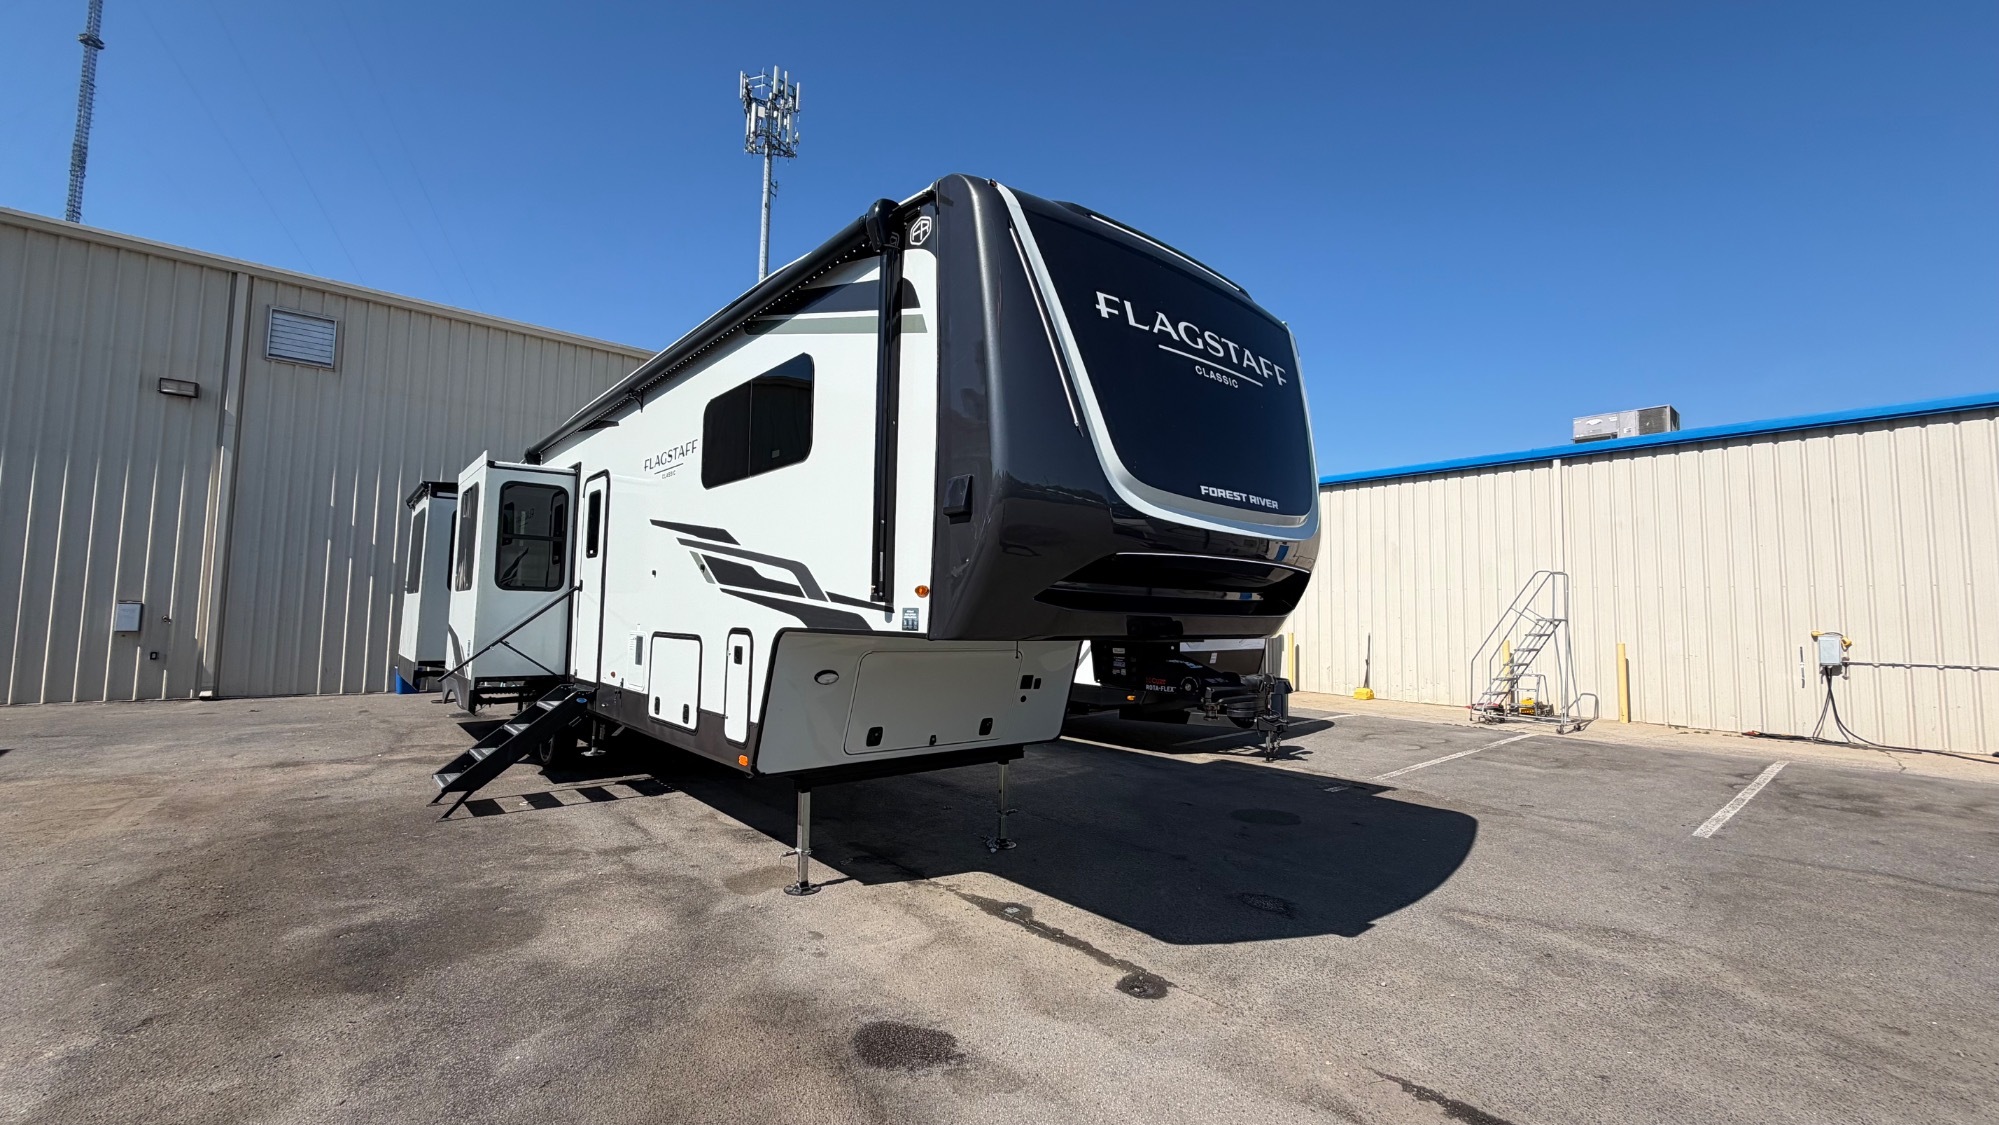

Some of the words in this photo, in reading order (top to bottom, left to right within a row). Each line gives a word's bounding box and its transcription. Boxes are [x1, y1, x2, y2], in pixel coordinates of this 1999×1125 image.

[1095, 291, 1288, 387] FLAGSTAFF
[1195, 366, 1239, 388] CLASSIC
[643, 439, 698, 472] FLAGSTAFF
[661, 470, 676, 480] CLASSIC
[1200, 485, 1247, 503] FOREST
[1250, 494, 1279, 510] RIVER
